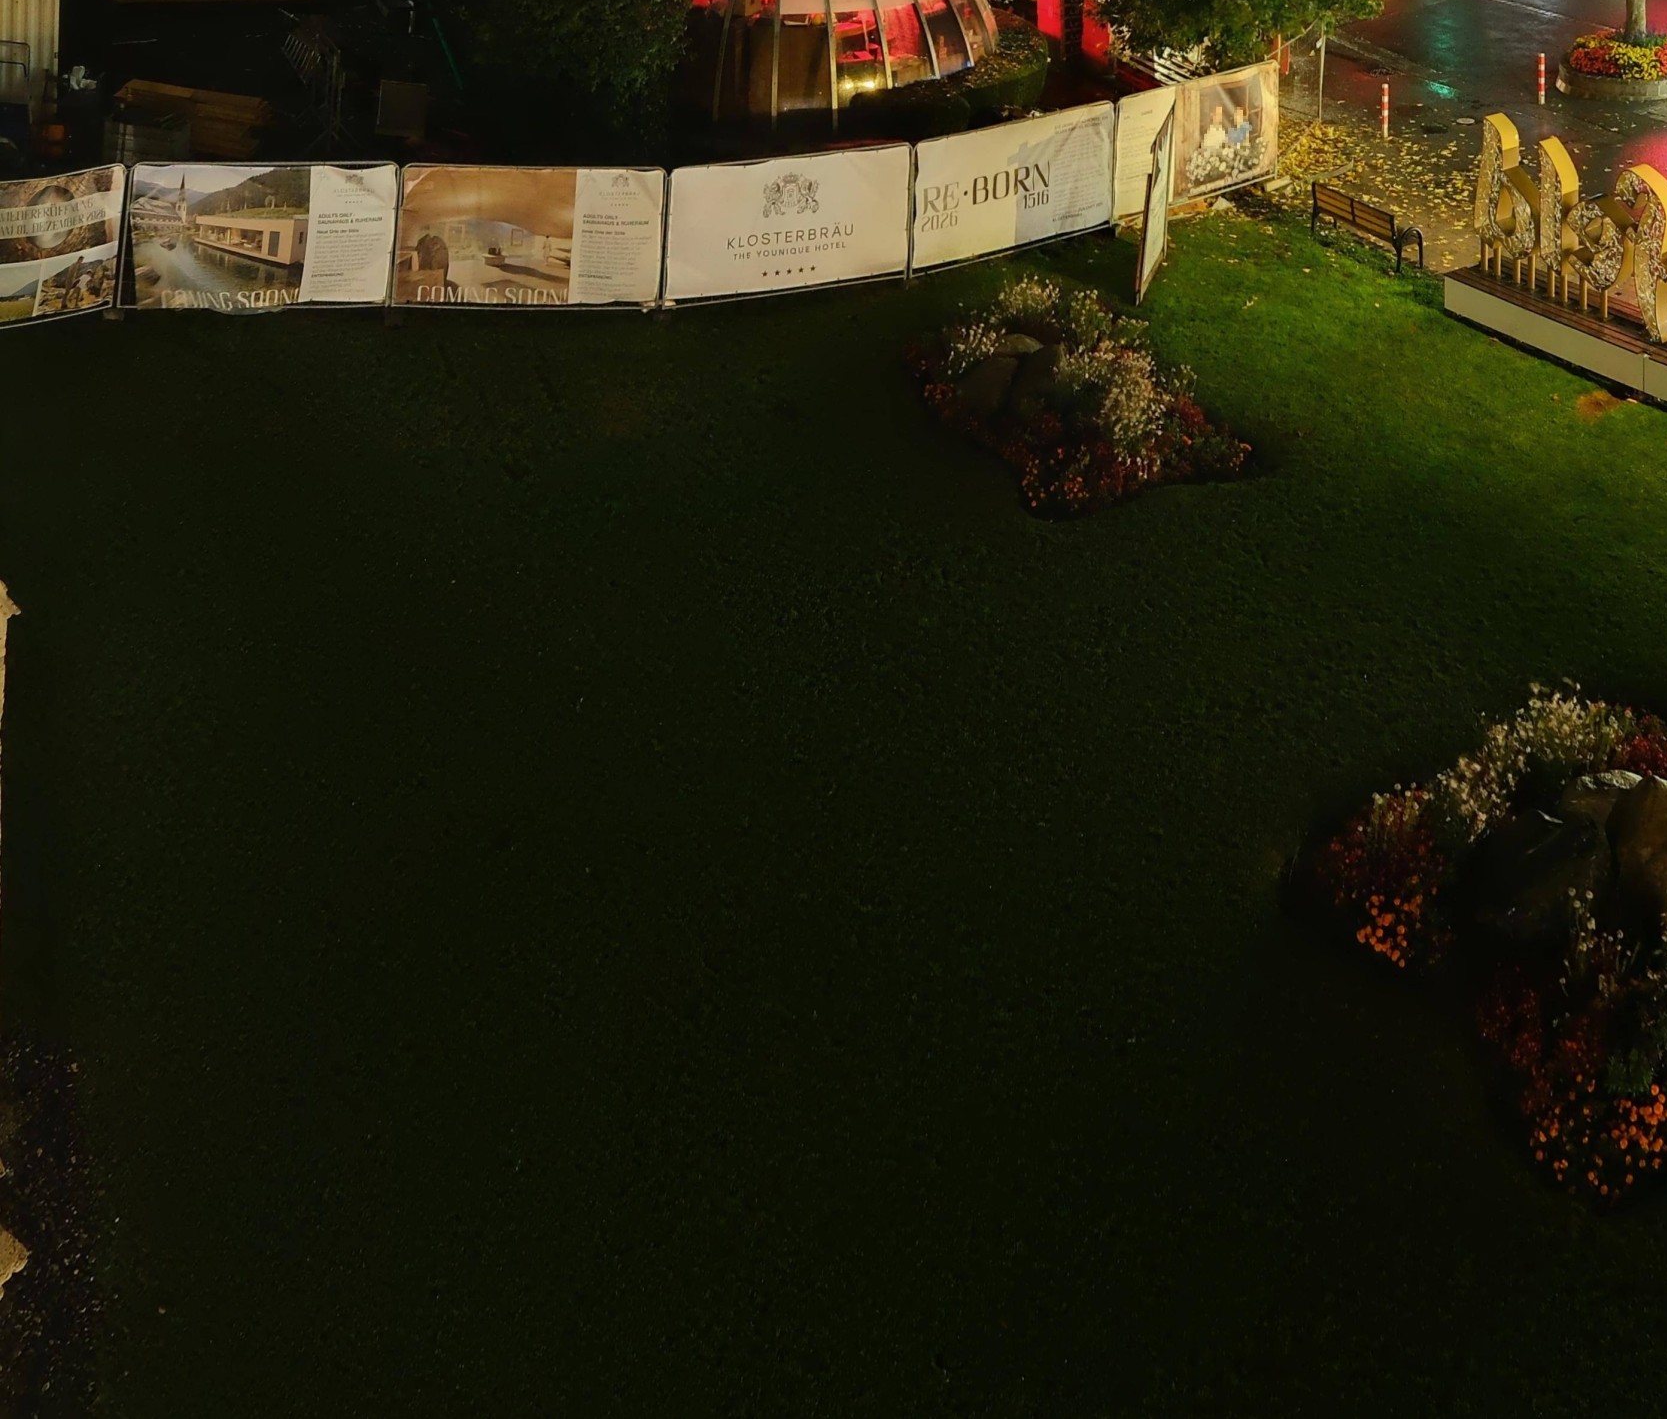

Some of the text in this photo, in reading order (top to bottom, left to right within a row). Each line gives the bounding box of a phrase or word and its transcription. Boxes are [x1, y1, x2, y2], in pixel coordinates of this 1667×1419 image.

[1022, 189, 1050, 209] 1516
[920, 210, 959, 233] 2026
[727, 222, 855, 250] KLOSTERBRÄU
[733, 241, 847, 261] THE YOUNIQUE HOTEL
[416, 284, 498, 303] COMING
